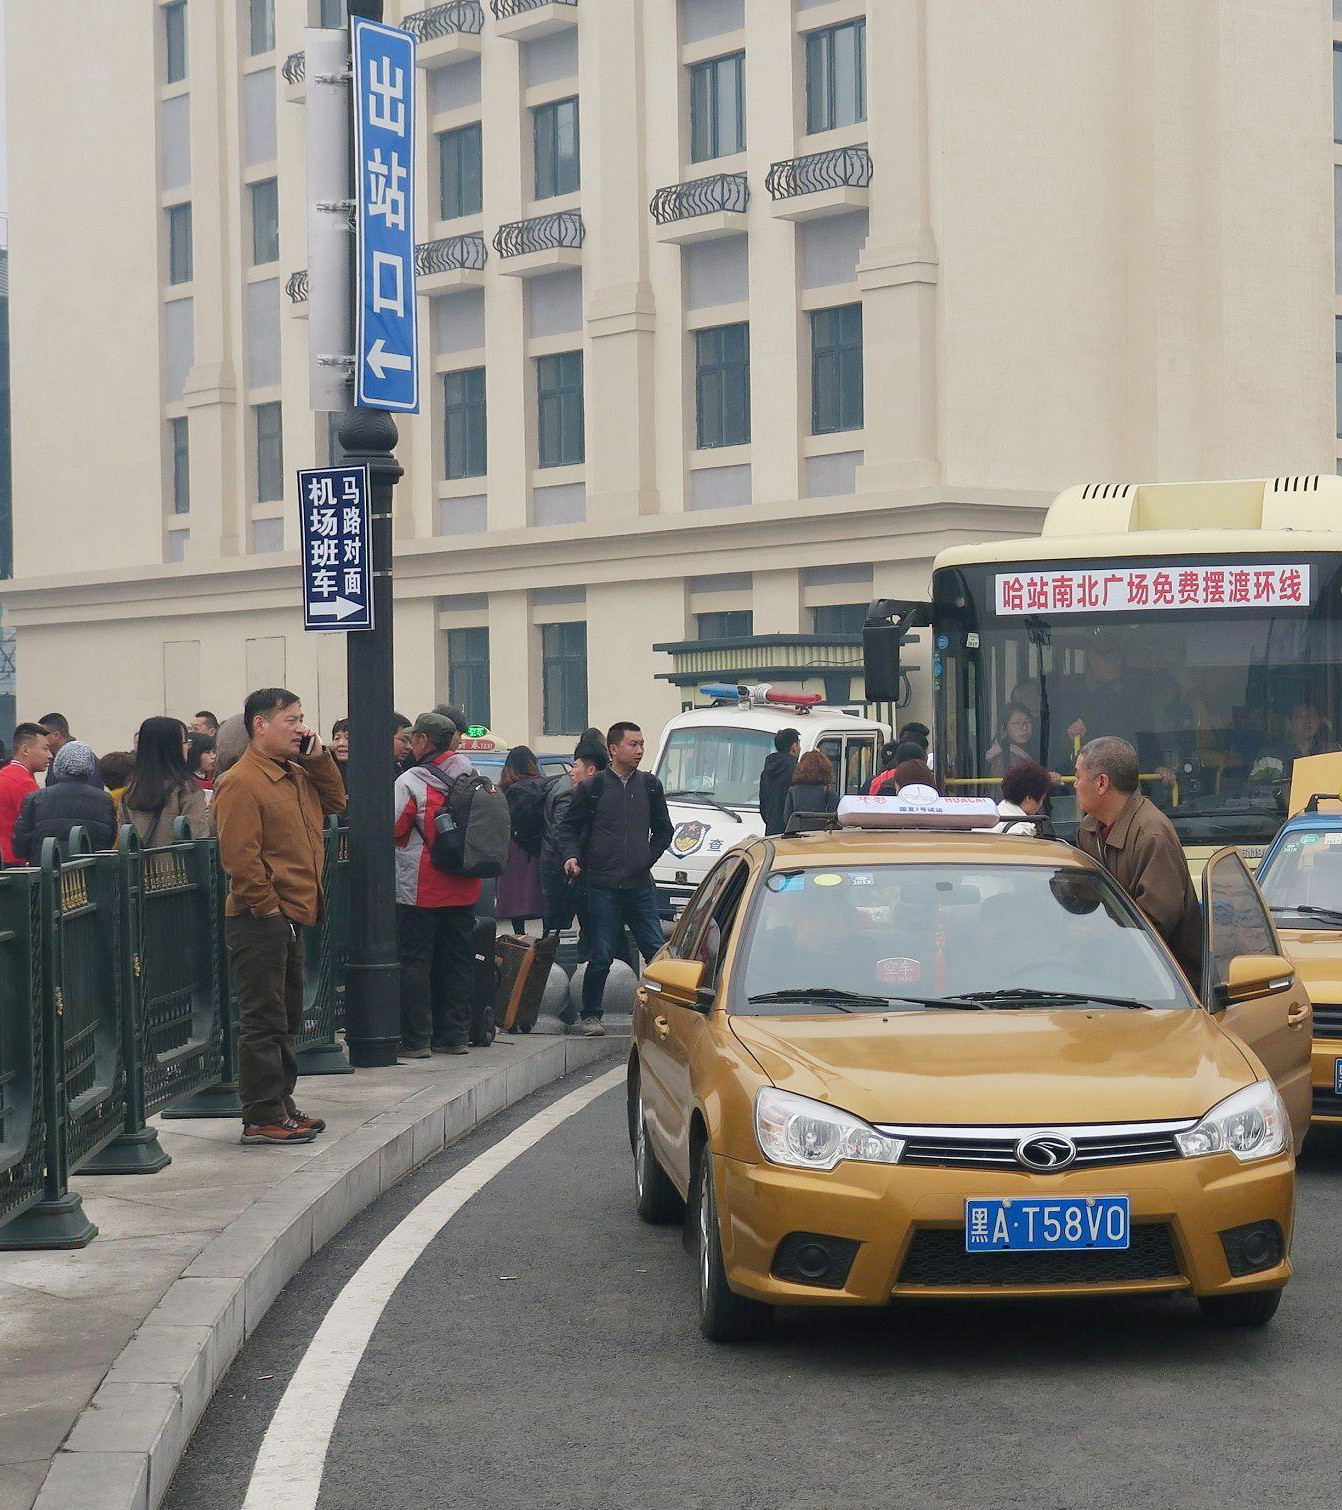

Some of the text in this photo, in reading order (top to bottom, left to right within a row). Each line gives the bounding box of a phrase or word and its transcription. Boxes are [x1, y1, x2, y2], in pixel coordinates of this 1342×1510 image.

[368, 55, 406, 318] 出站口
[308, 477, 340, 598] 机场班车
[342, 476, 362, 596] 马路对面
[1002, 569, 1302, 611] 哈站南北广场免费摆渡环线
